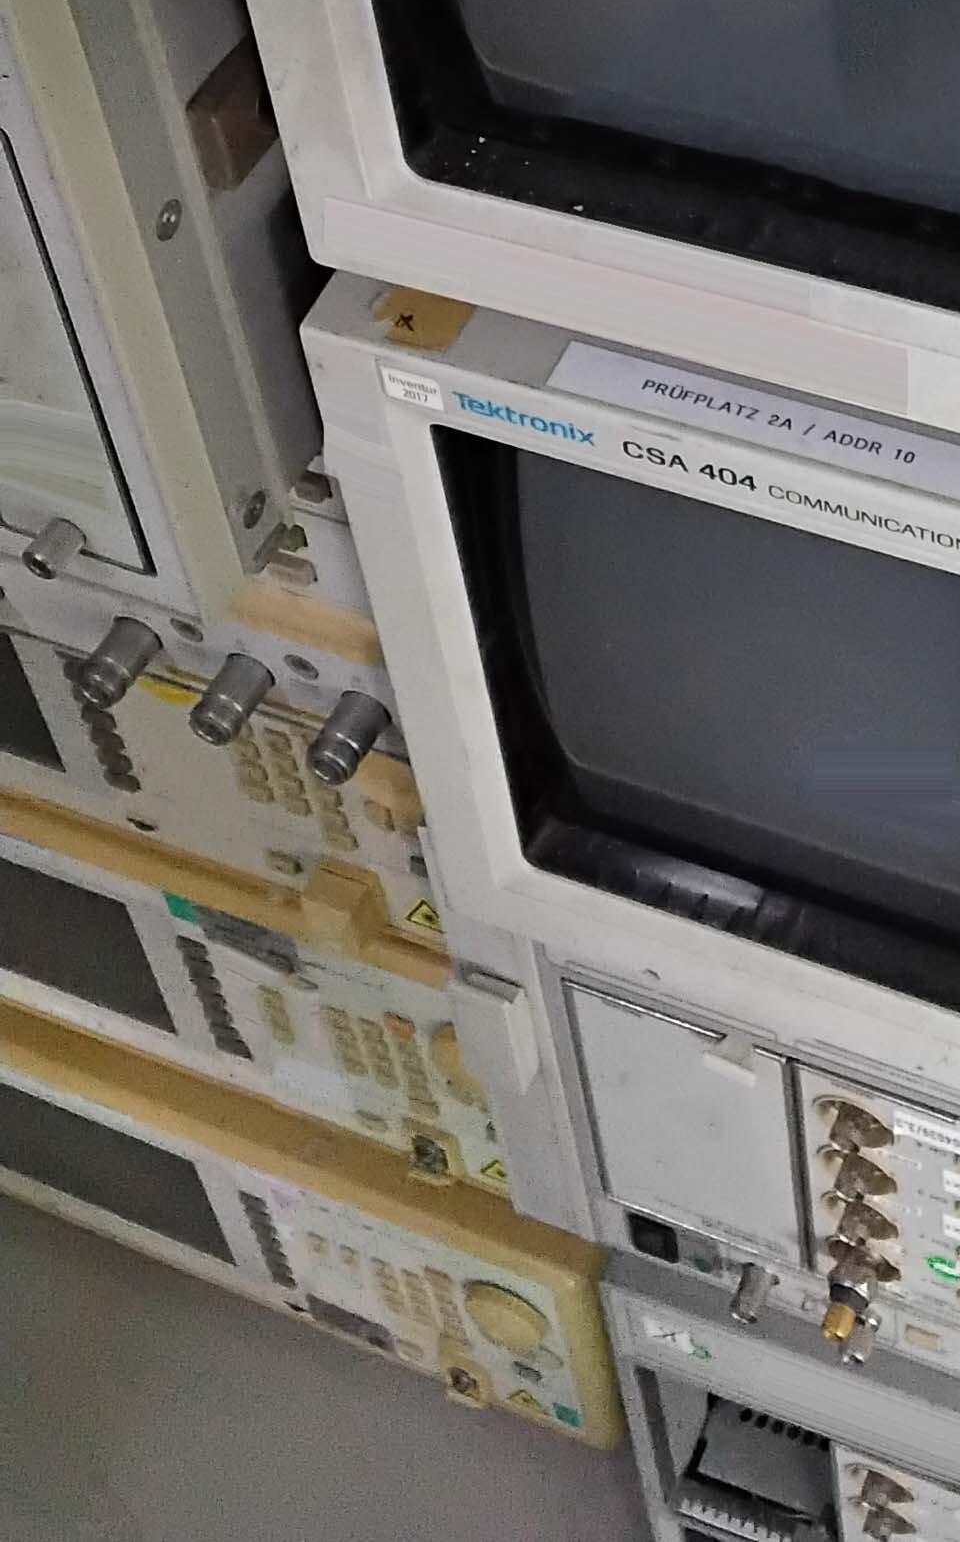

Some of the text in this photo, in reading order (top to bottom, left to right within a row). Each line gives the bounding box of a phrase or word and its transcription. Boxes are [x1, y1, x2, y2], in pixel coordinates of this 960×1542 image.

[402, 387, 428, 404] 2017
[641, 376, 916, 465] PRÜFPLATZ 2A / ADDR 10
[452, 390, 595, 447] Tektronix
[622, 440, 688, 472] CSA
[699, 464, 757, 493] 404
